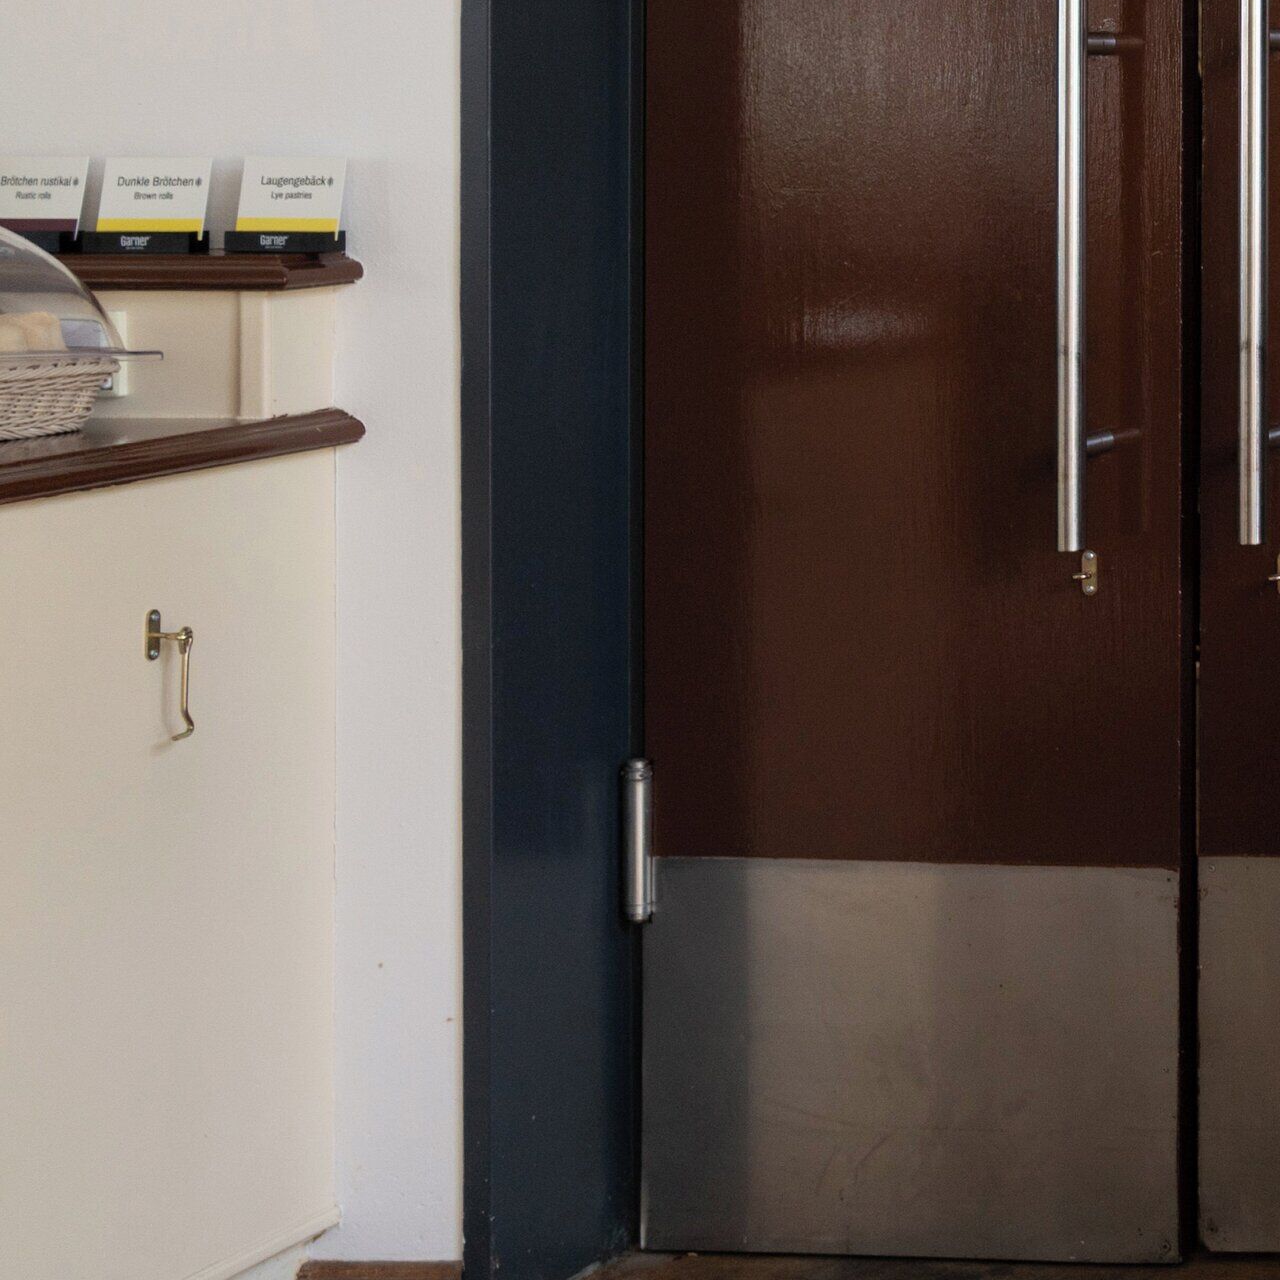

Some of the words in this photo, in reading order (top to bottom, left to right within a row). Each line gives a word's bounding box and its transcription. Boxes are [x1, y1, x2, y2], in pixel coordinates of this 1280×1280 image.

[0, 176, 38, 186] Brötchen
[40, 176, 72, 186] rustikal
[117, 176, 150, 187] Dunkle
[152, 176, 194, 187] Brötchen
[261, 176, 326, 188] Laugengebäck
[15, 191, 36, 199] Rustic
[134, 191, 157, 200] Brown
[158, 191, 173, 200] rolls
[271, 191, 284, 200] Lye
[284, 191, 312, 200] pastries
